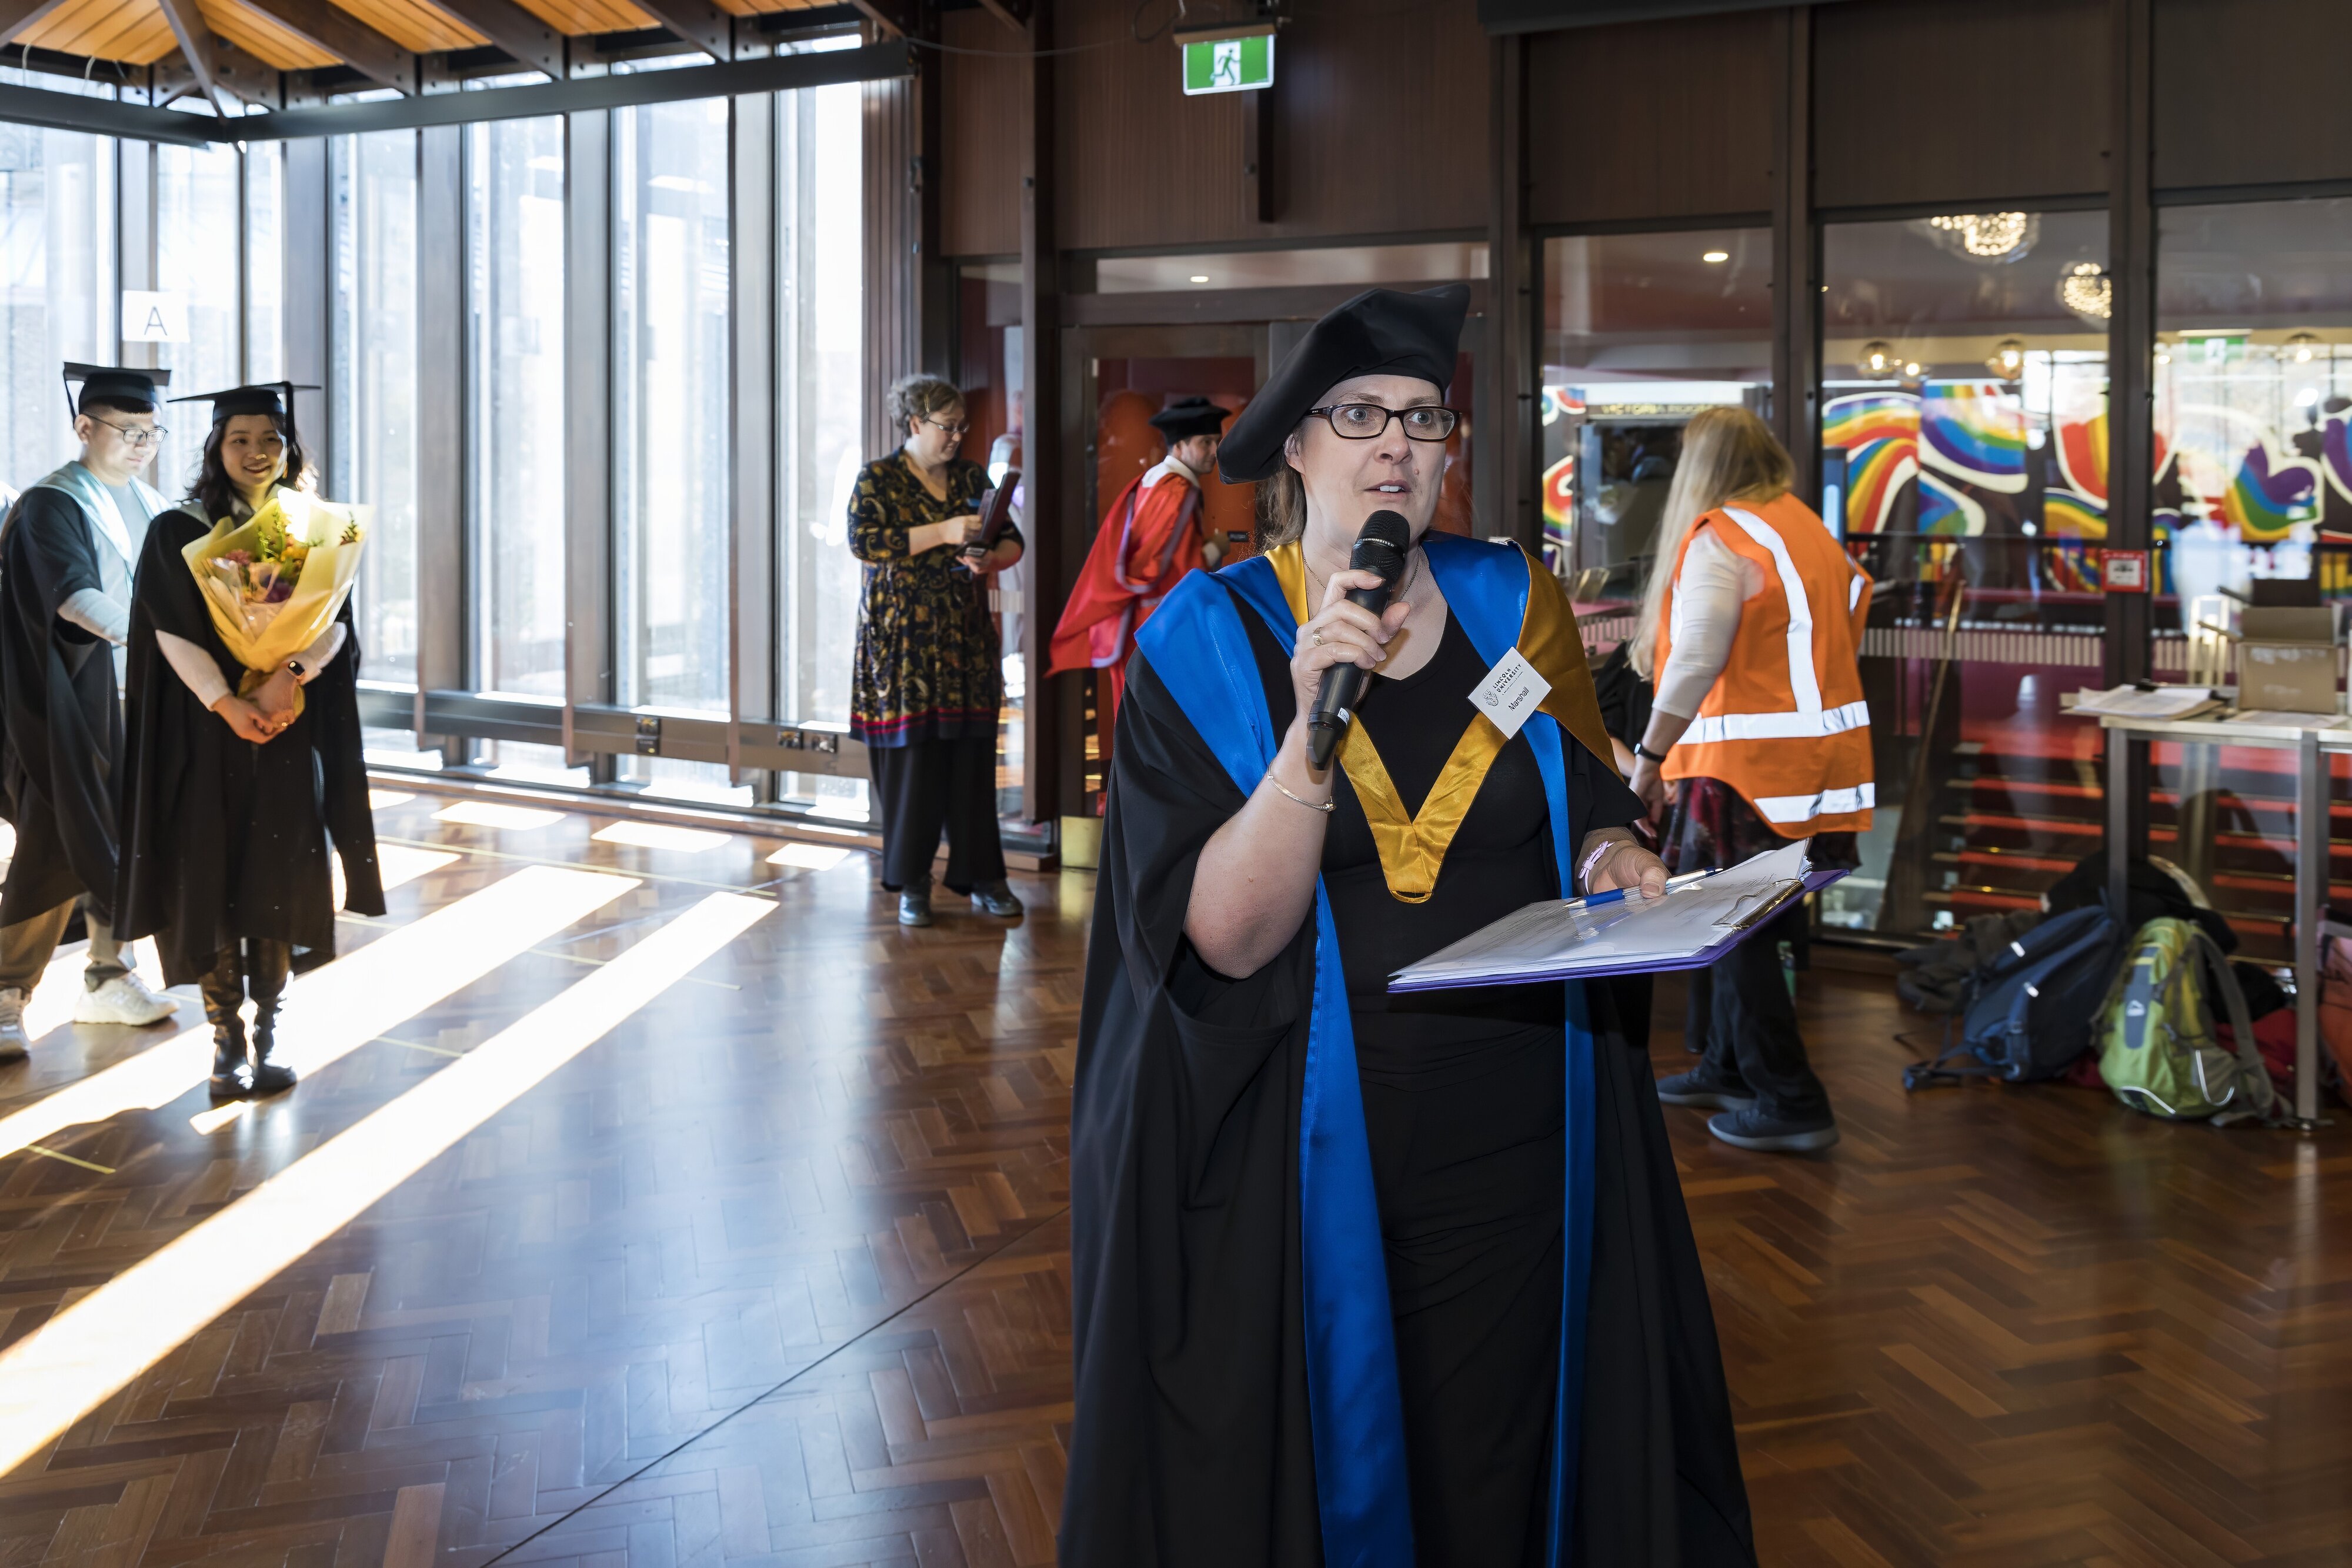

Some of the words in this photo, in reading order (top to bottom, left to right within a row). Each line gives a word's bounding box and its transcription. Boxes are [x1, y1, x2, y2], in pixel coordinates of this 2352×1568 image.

[144, 306, 168, 336] A
[1493, 668, 1511, 689] LINCOLN
[1496, 663, 1521, 692] UNIVERSITY
[1508, 686, 1529, 711] Marshall
